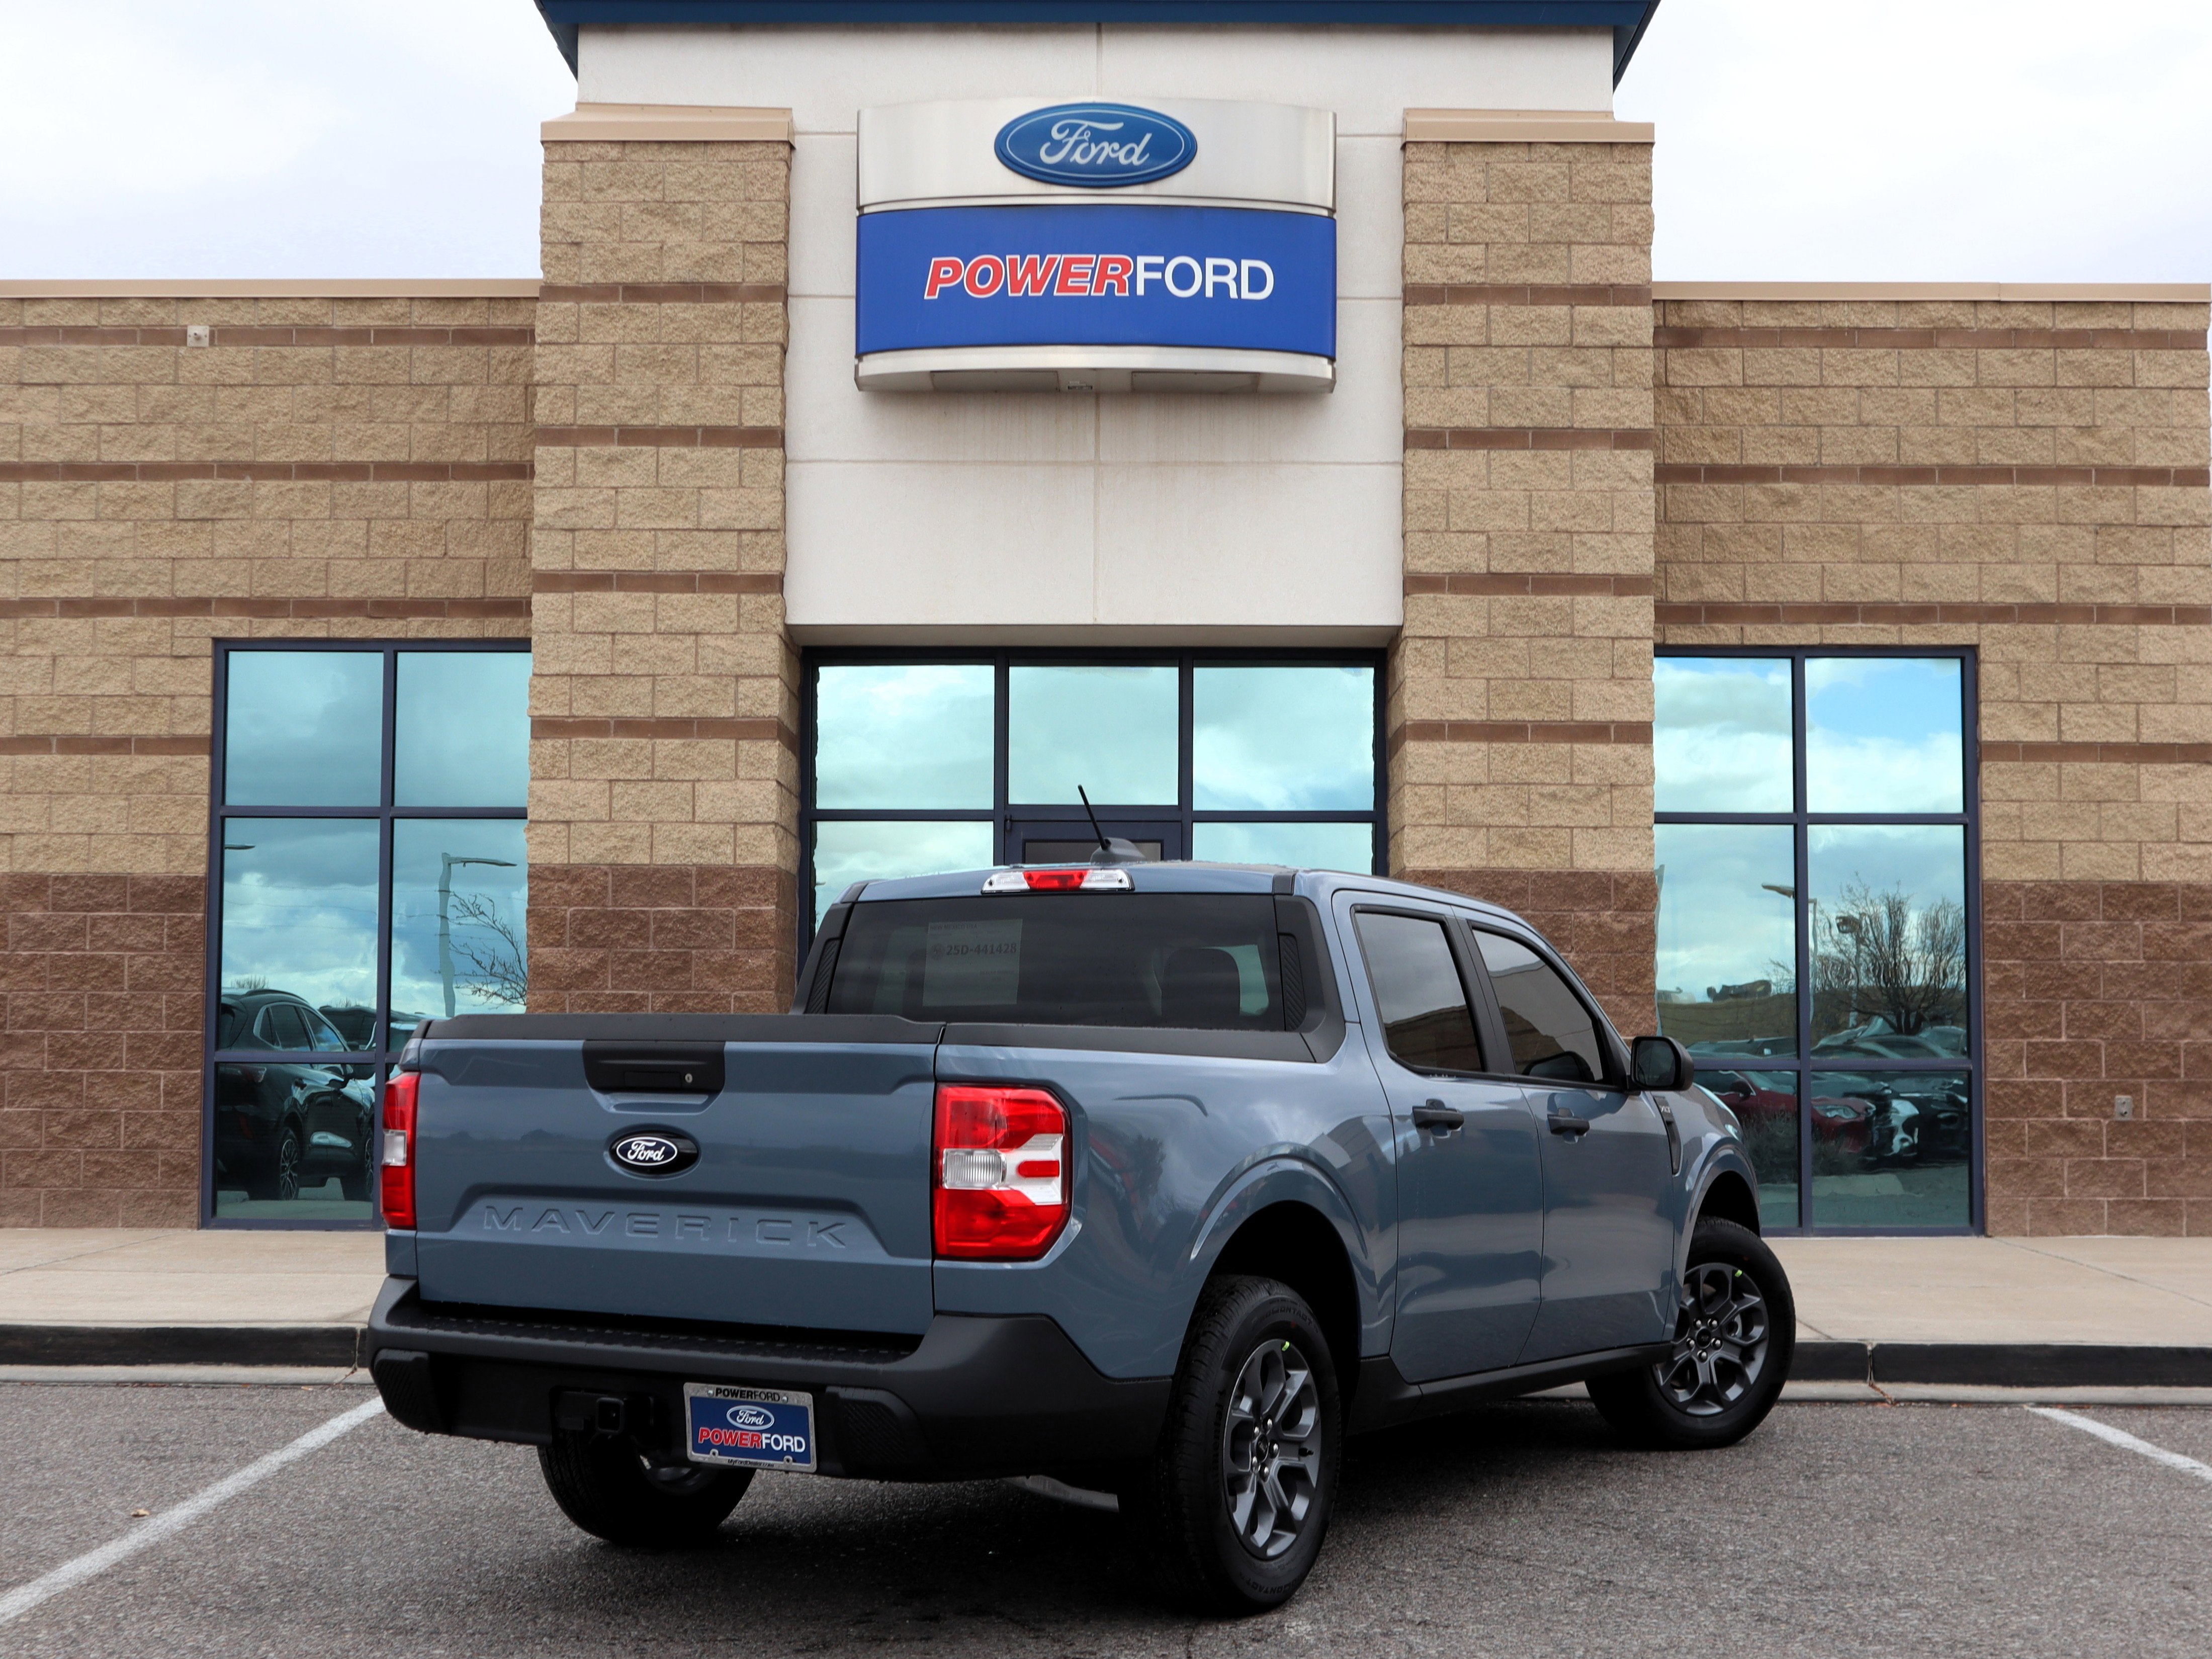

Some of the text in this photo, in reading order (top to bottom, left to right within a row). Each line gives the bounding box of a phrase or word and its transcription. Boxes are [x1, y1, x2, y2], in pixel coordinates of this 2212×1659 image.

[1039, 119, 1153, 166] Ford
[924, 254, 1274, 300] POWERFORD
[946, 943, 1017, 955] 25D-441428
[627, 1140, 666, 1161] Ford
[483, 1206, 846, 1249] MAVERICK
[715, 1387, 780, 1402] POWERFORD
[736, 1410, 764, 1425] Ford
[698, 1427, 806, 1452] POWERFORD
